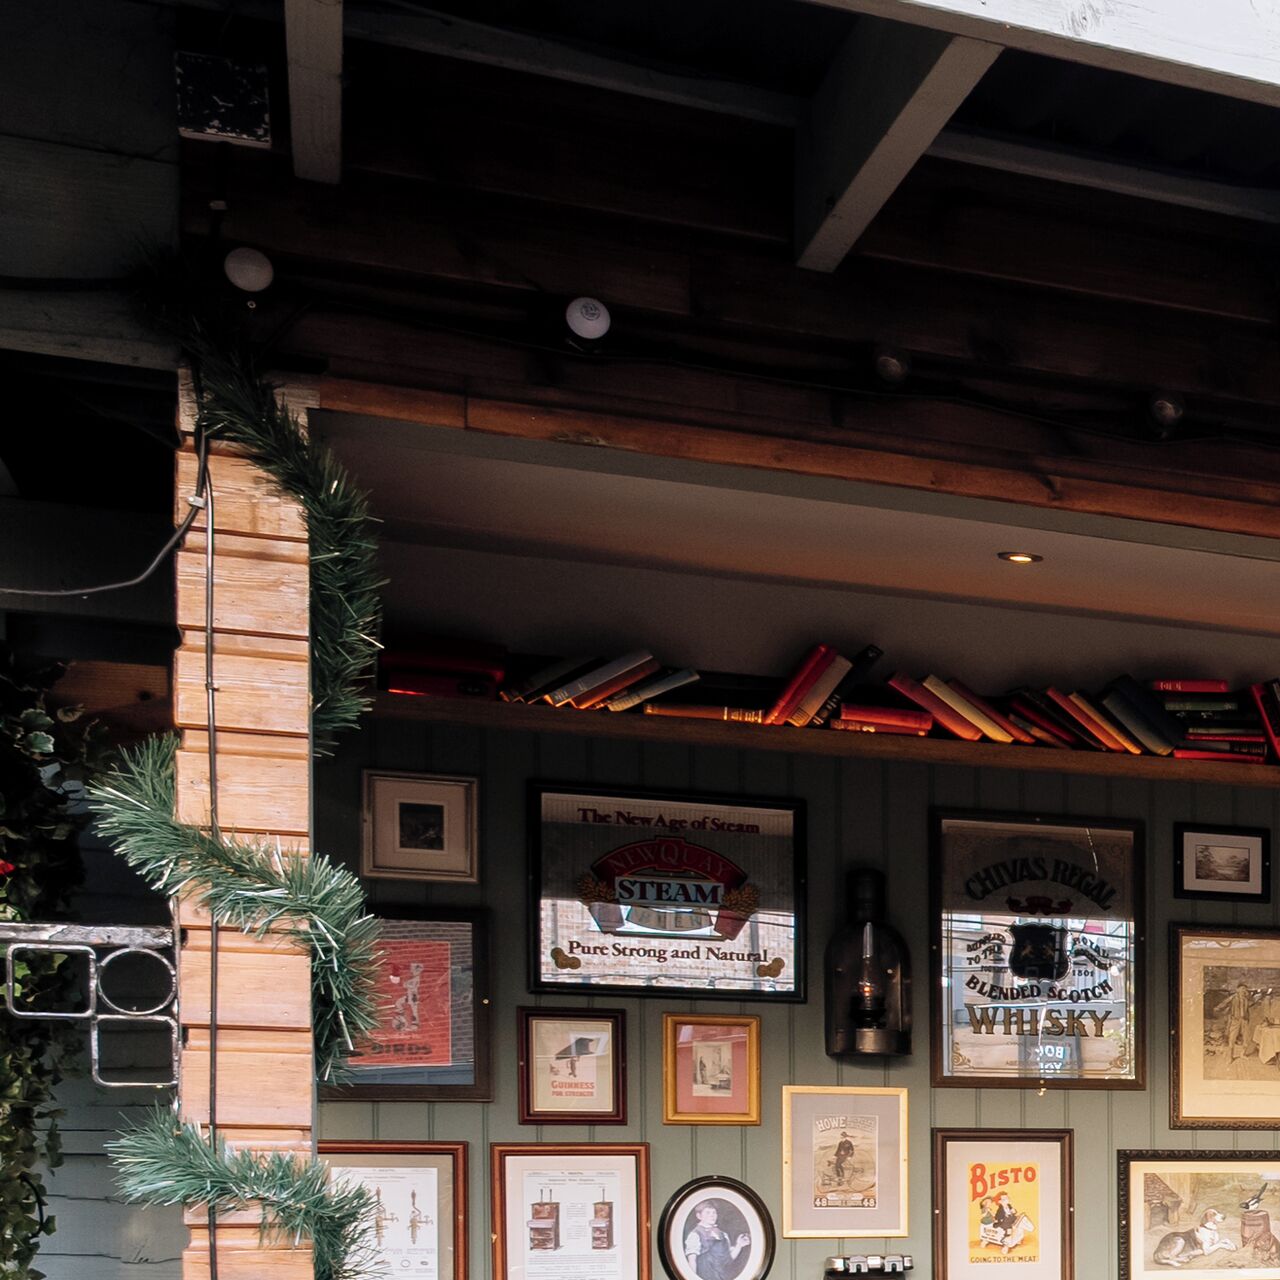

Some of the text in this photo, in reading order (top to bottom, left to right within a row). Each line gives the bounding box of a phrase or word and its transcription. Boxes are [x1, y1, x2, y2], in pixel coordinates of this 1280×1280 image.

[578, 808, 760, 834] The New Age of Steam
[618, 879, 721, 904] STEAM
[966, 857, 1116, 912] CHIVAS REGAL
[568, 940, 609, 957] Pure
[612, 944, 668, 963] Strong
[671, 946, 702, 960] and
[706, 947, 769, 963] Natural
[965, 974, 1114, 1004] BLENDED SCOTCH
[964, 1003, 1112, 1038] WHISKY
[551, 1080, 595, 1090] GUINNESS
[816, 1117, 848, 1132] HOWE
[970, 1163, 1036, 1202] BISTO
[1018, 1255, 1037, 1263] MEAT
